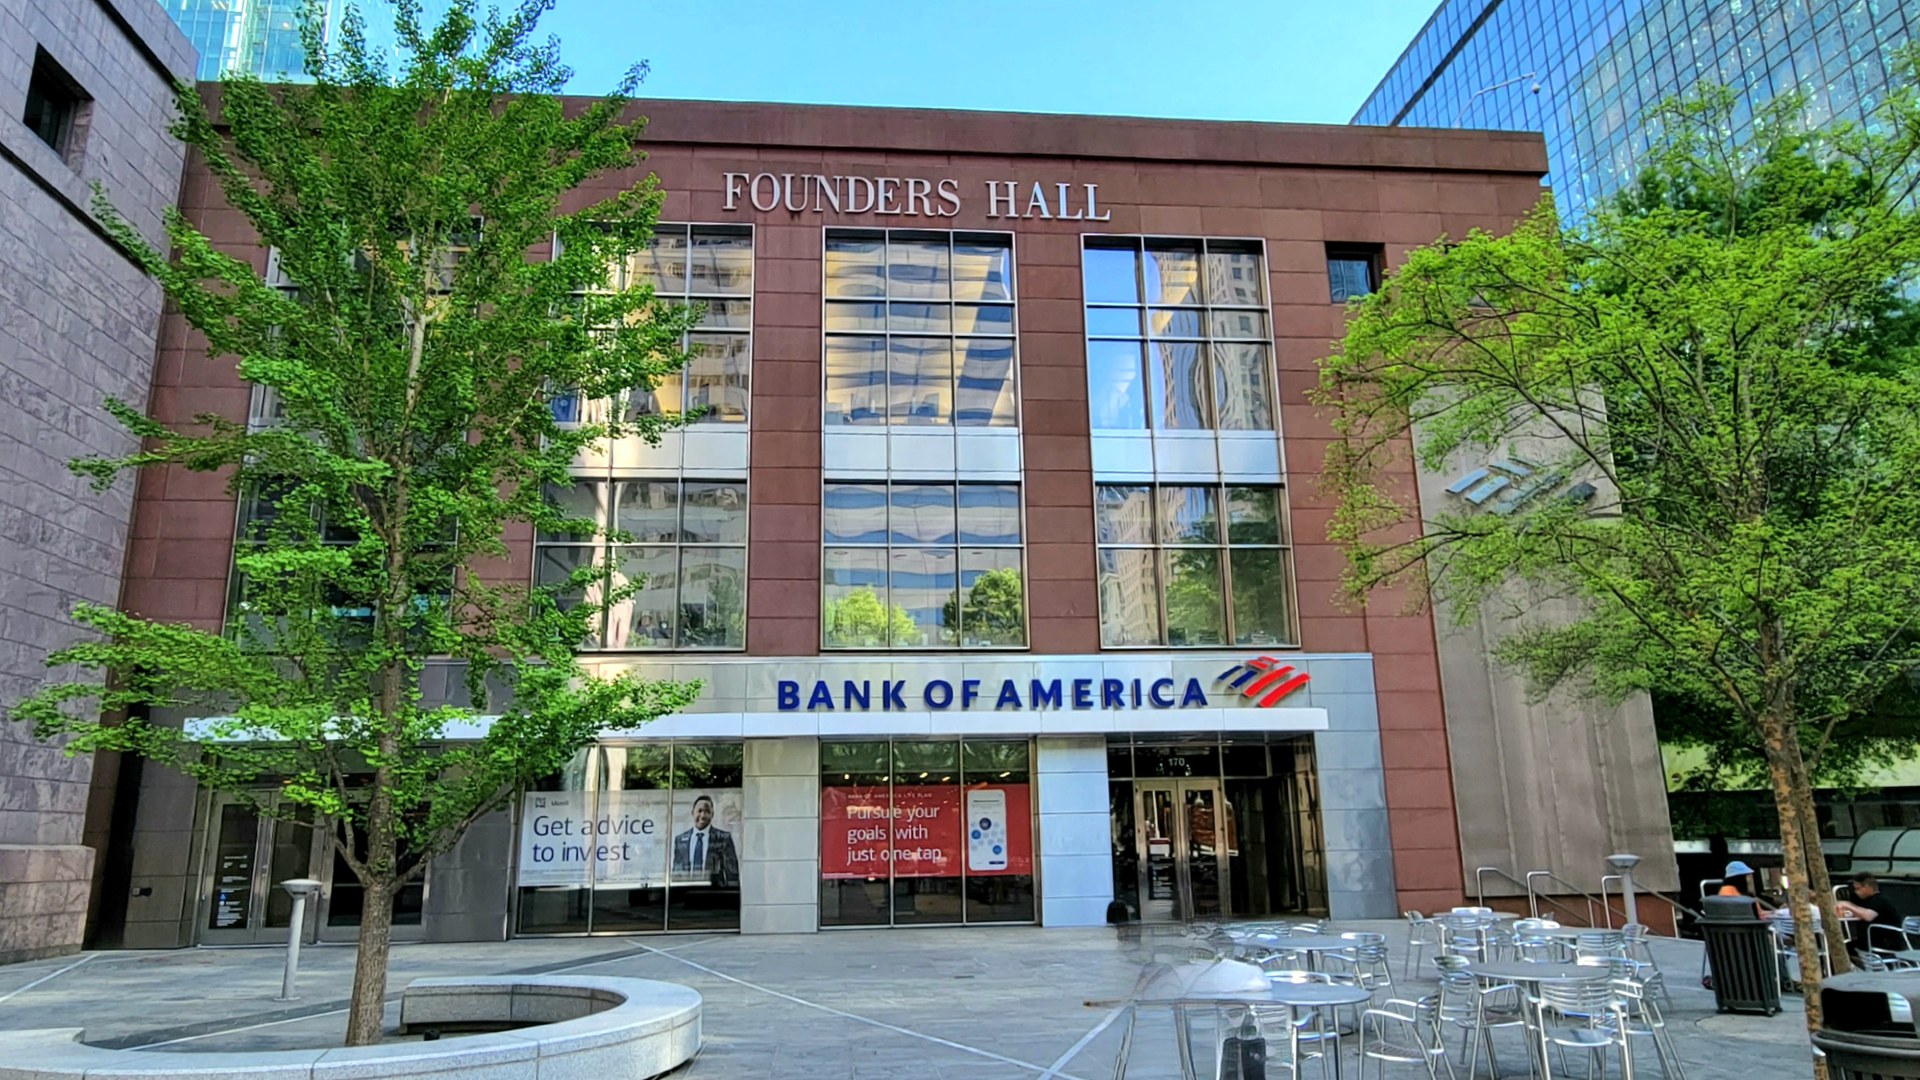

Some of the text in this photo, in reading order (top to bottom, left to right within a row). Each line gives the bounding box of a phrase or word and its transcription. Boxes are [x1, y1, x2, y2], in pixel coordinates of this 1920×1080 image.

[723, 173, 1112, 222] FOUNDERS HALL
[777, 678, 1208, 711] BANK OF AMERICA
[1168, 757, 1185, 767] 170
[847, 805, 940, 822] Pursue your
[533, 814, 654, 836] Get advice
[847, 823, 928, 844] goals with
[532, 841, 631, 862] to invest
[847, 847, 942, 865] just one tap
